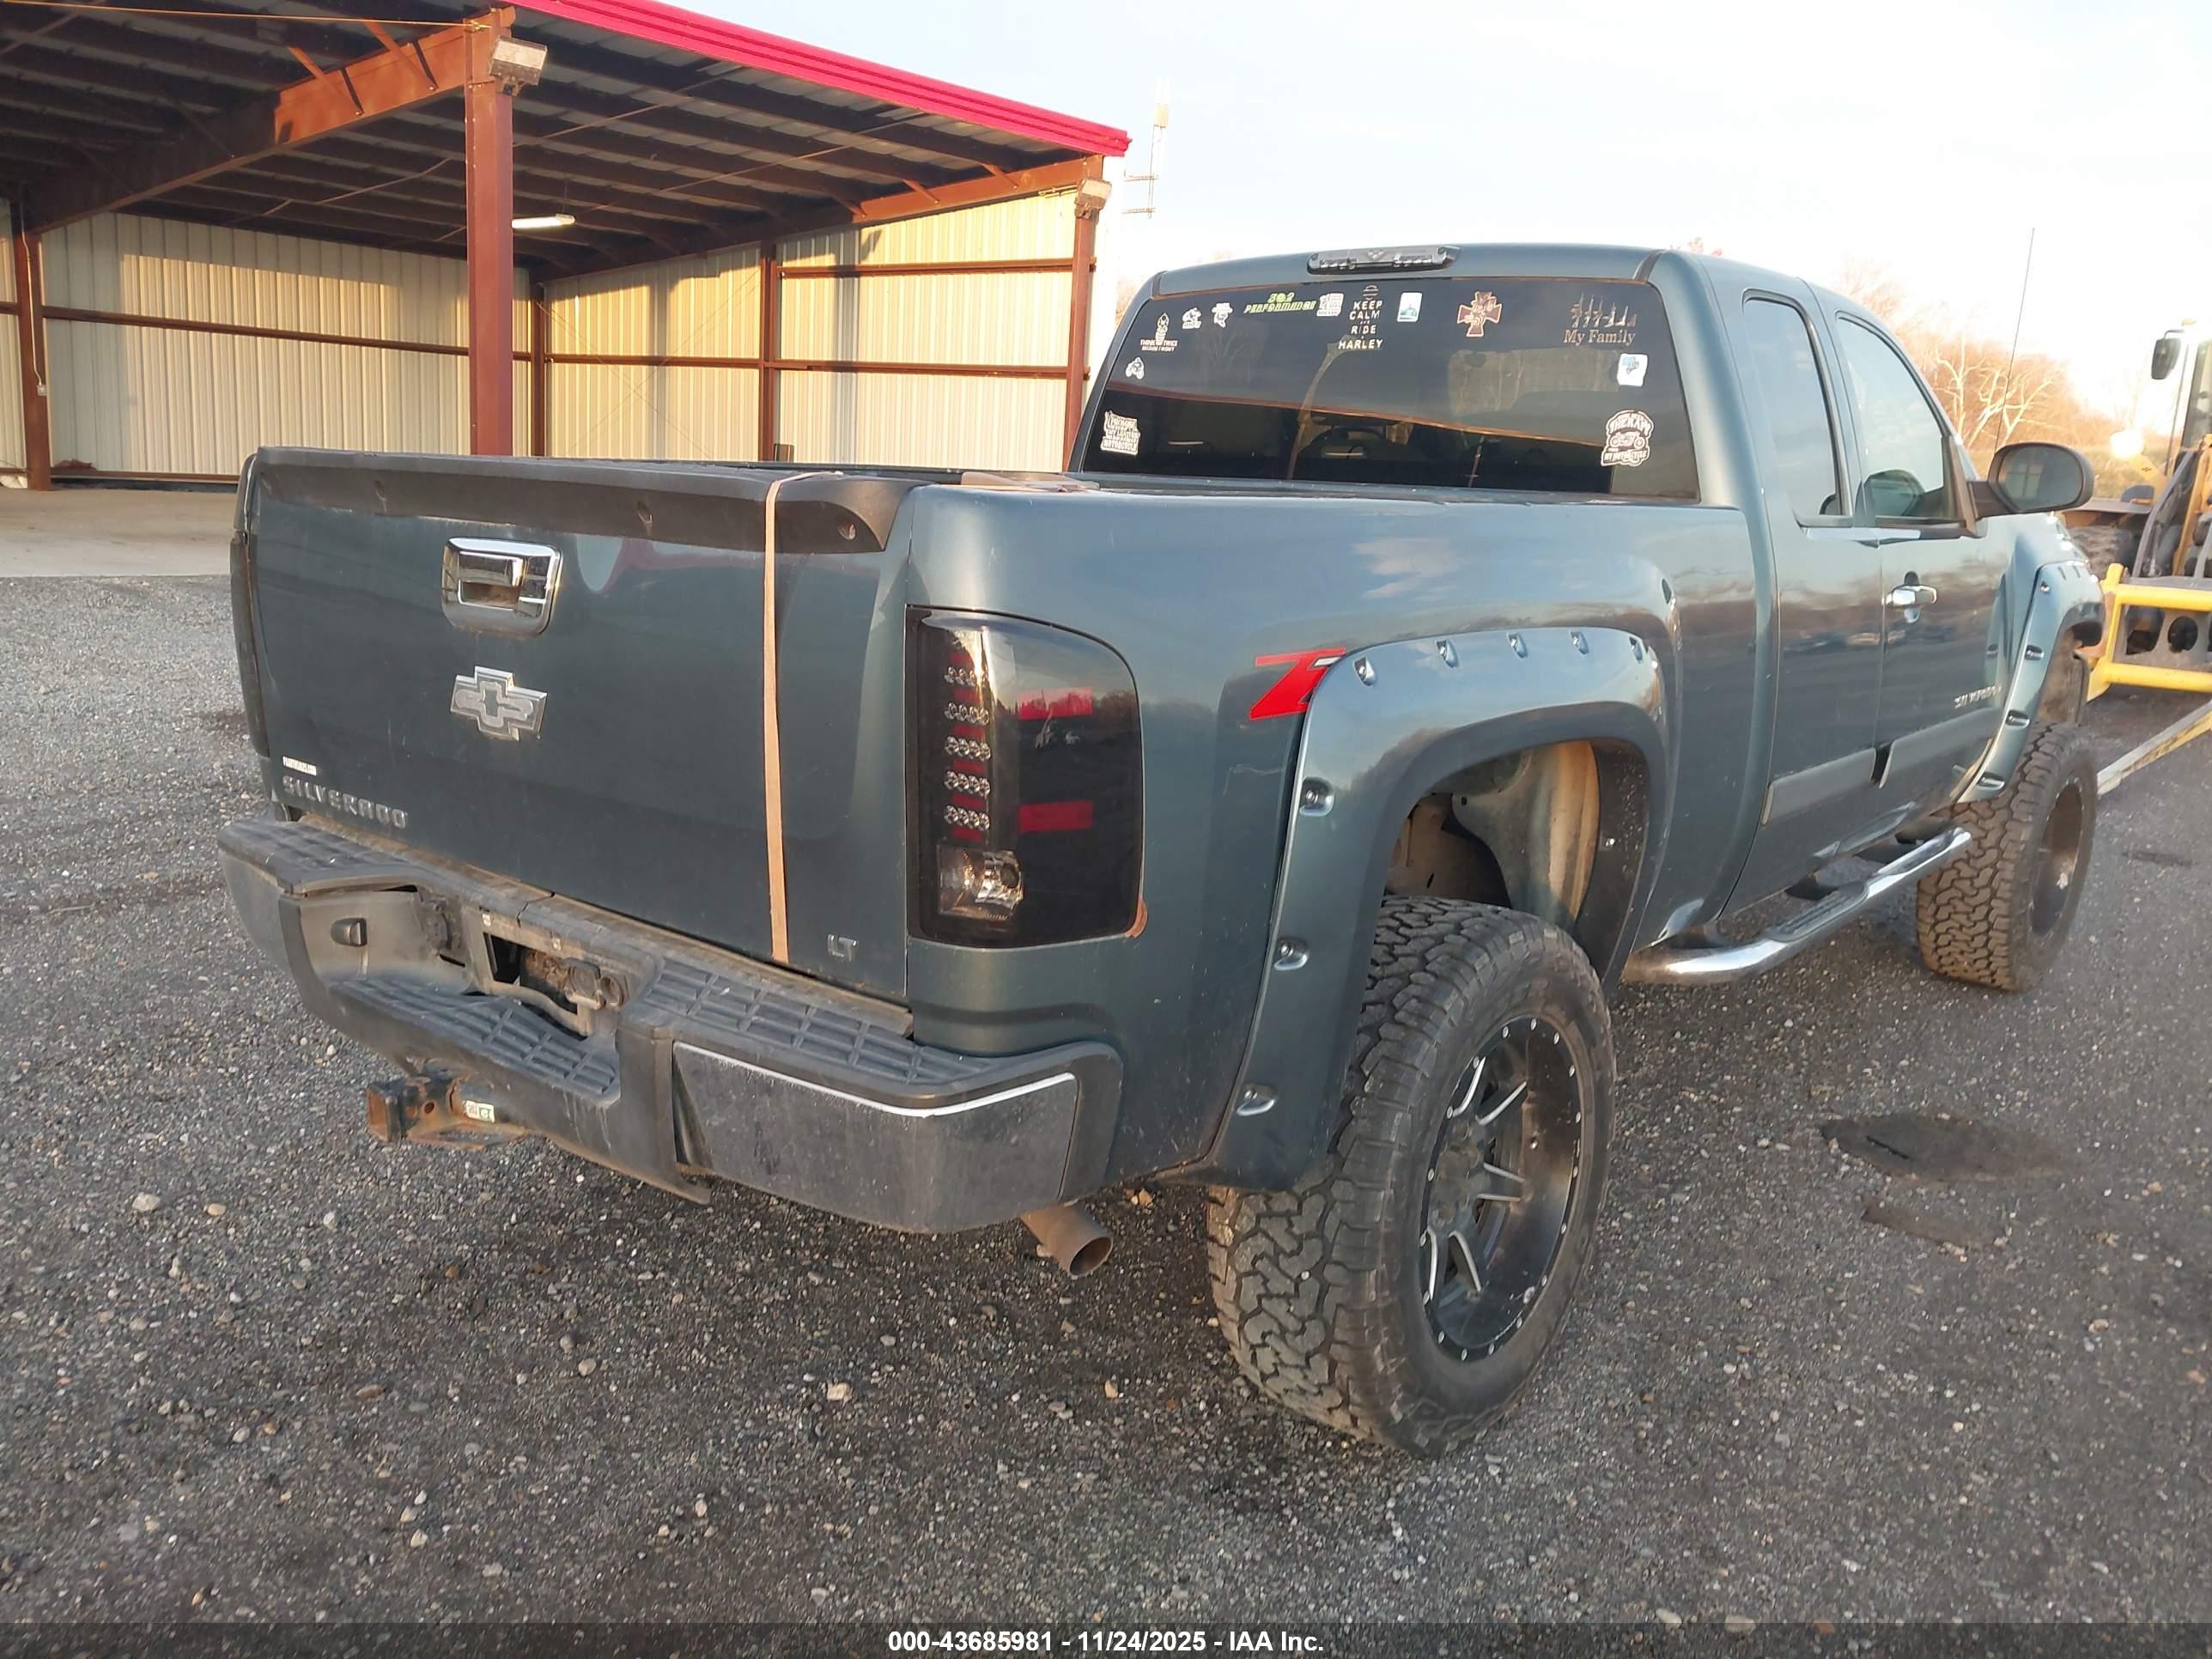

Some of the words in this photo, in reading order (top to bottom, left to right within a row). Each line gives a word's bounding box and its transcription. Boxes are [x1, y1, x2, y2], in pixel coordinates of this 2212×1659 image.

[1353, 300, 1382, 310] KEEP
[1349, 309, 1381, 320] CALM
[1351, 325, 1376, 335] RIDE
[1564, 329, 1585, 346] My
[1589, 329, 1636, 346] Family
[1338, 338, 1383, 350] HARLEY
[283, 775, 408, 829] SILVERADO
[827, 933, 857, 963] LT
